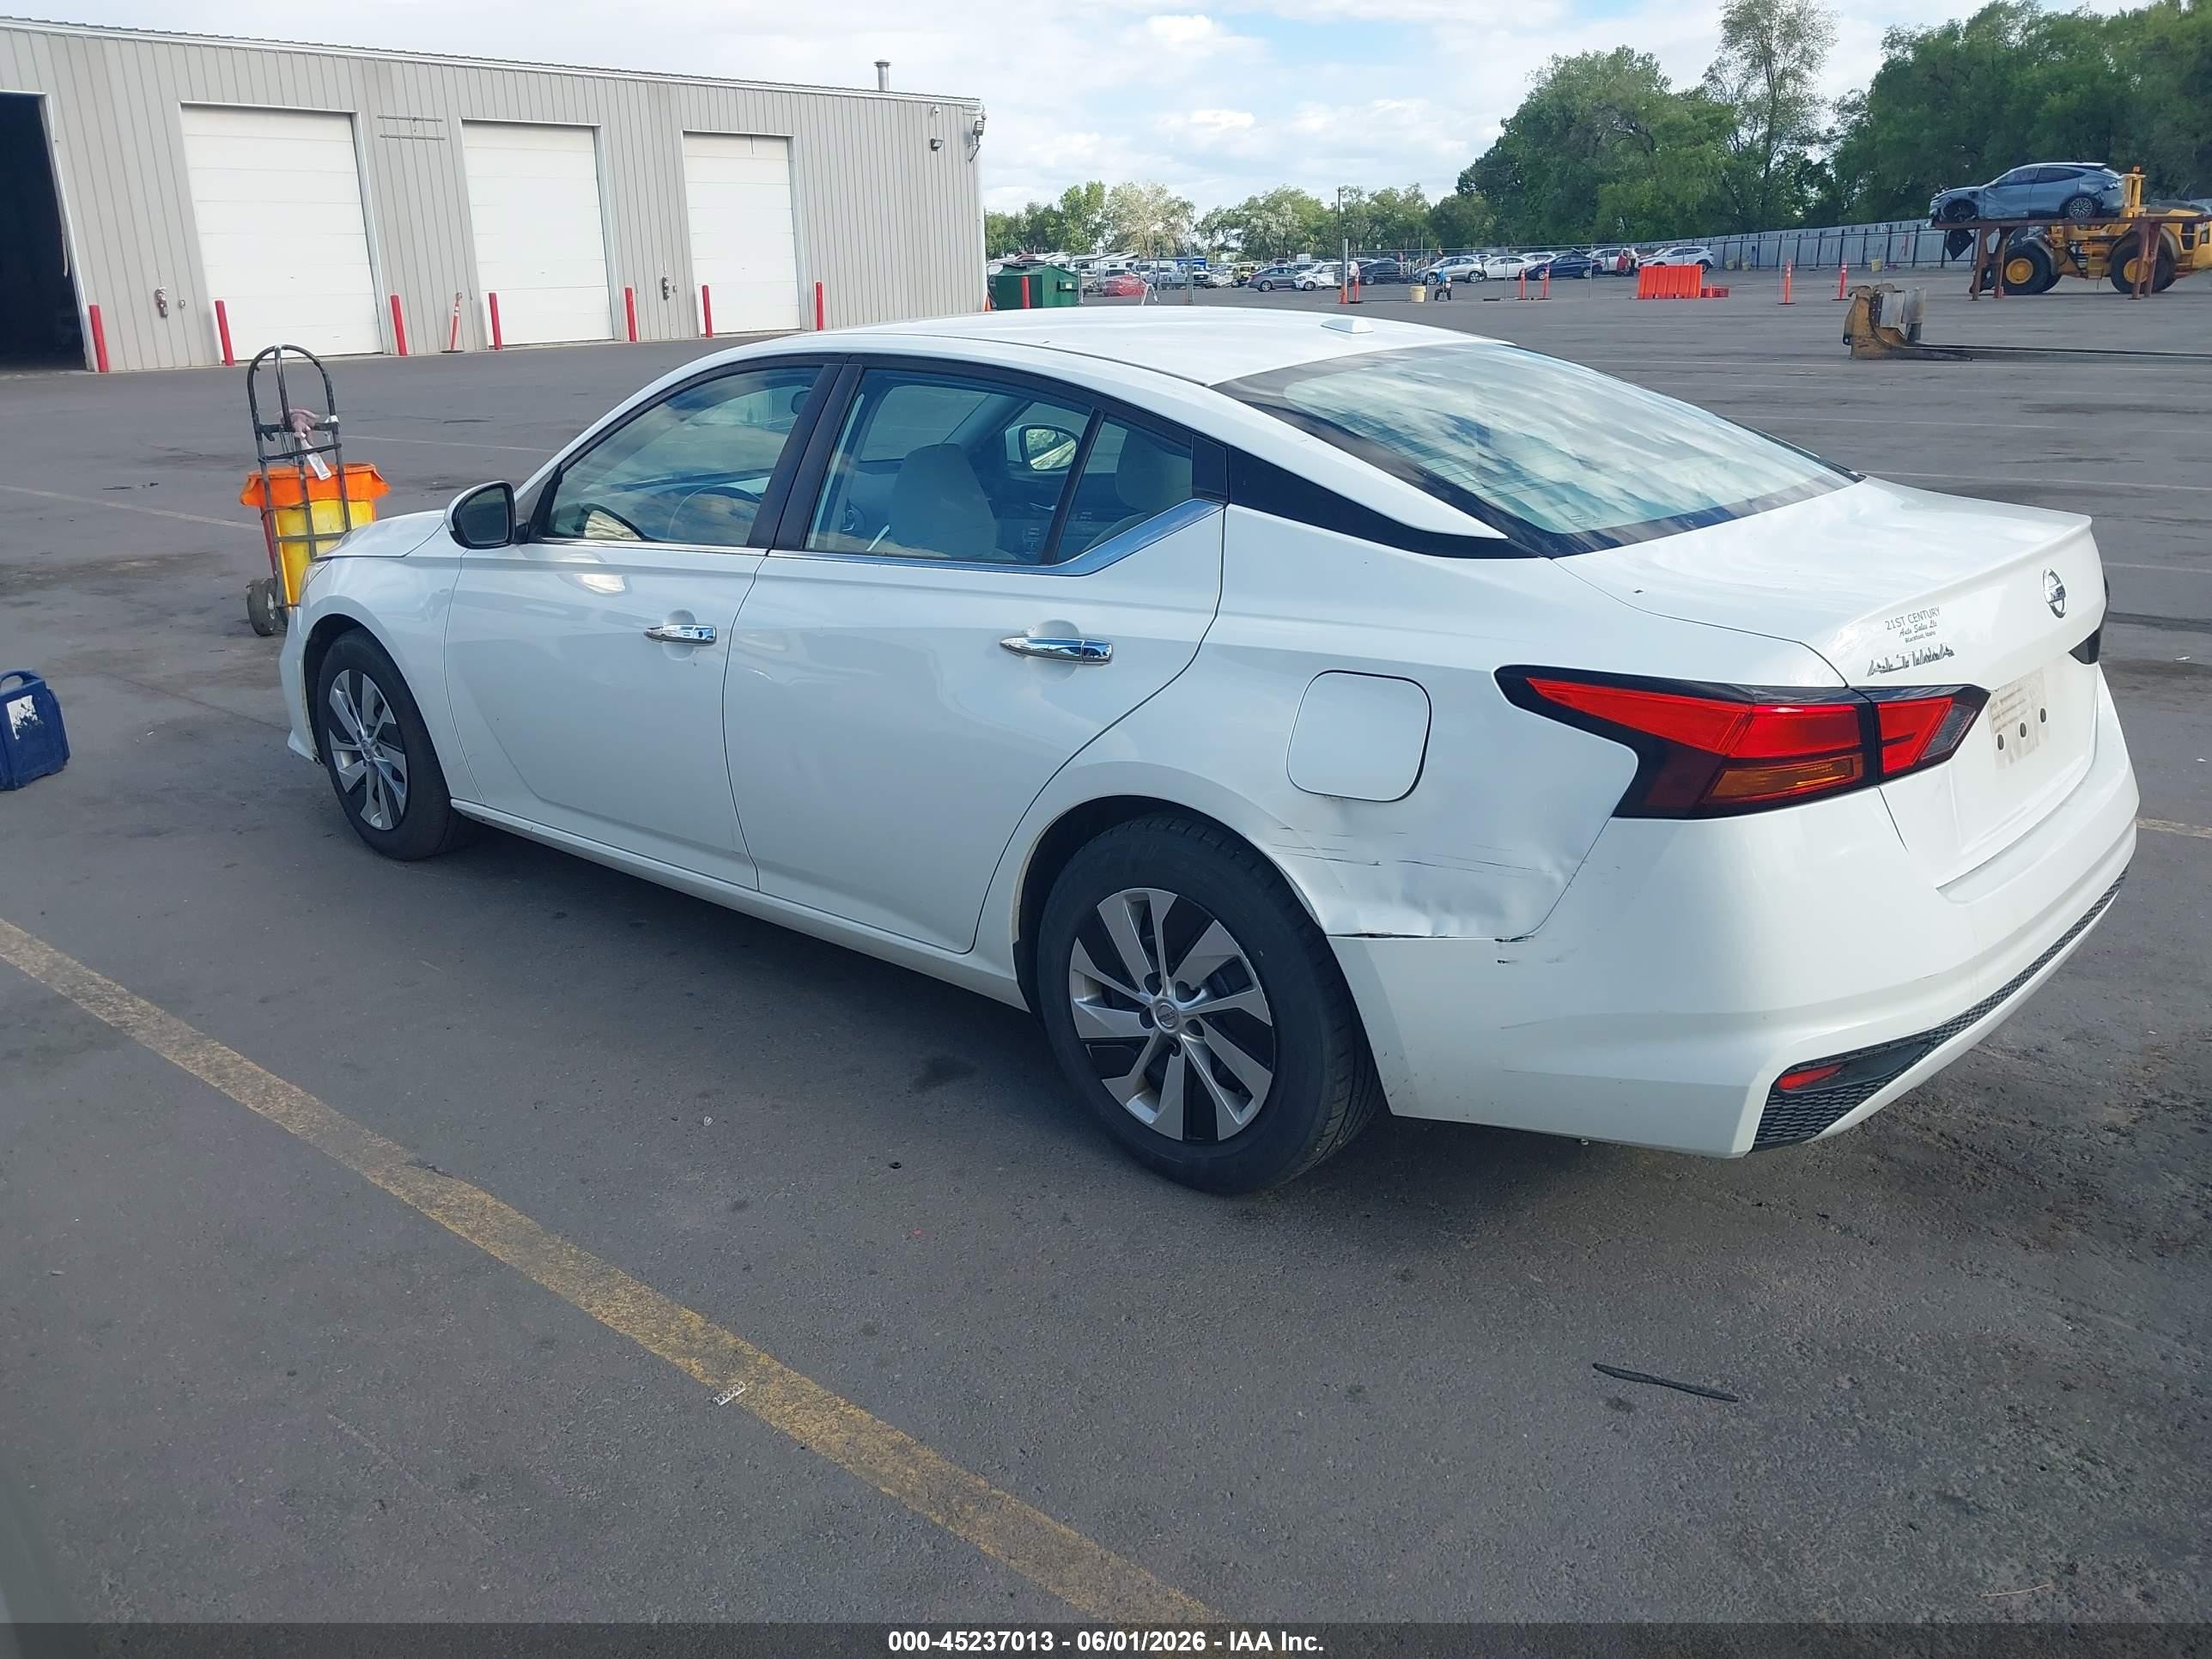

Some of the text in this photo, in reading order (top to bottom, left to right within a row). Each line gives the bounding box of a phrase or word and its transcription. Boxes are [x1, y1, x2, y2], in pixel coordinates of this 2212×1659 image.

[1885, 606, 1941, 630] 21ST CENTURY
[1899, 628, 1912, 638] Auto
[1914, 623, 1928, 633] Sales
